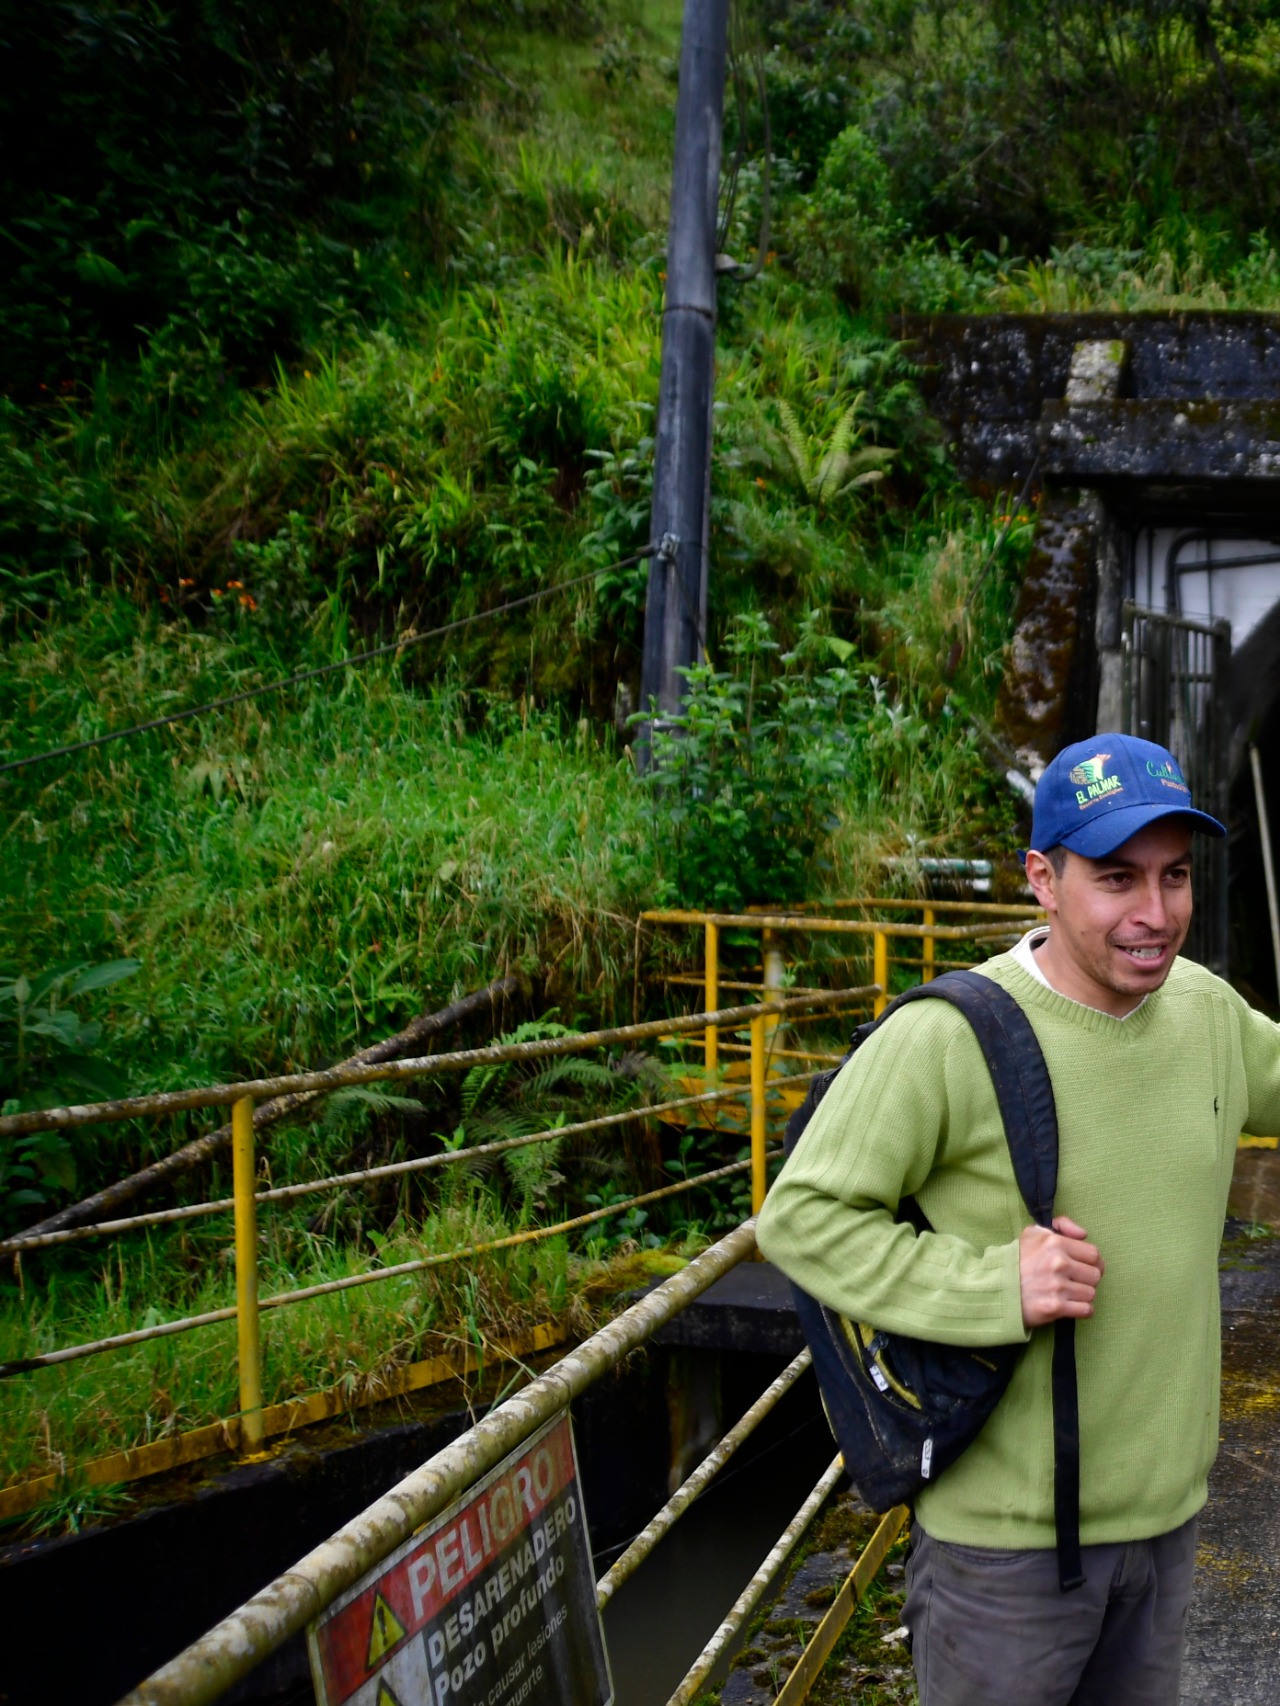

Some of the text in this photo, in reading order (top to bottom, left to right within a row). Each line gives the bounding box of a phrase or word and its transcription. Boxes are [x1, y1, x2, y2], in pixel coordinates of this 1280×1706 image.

[1075, 775, 1122, 805] EL PALMAR
[407, 1451, 554, 1622] PELIGRO
[428, 1496, 576, 1669] DESARENADERO
[434, 1555, 565, 1706] Pozo profundo
[487, 1603, 568, 1705] causar lesiones
